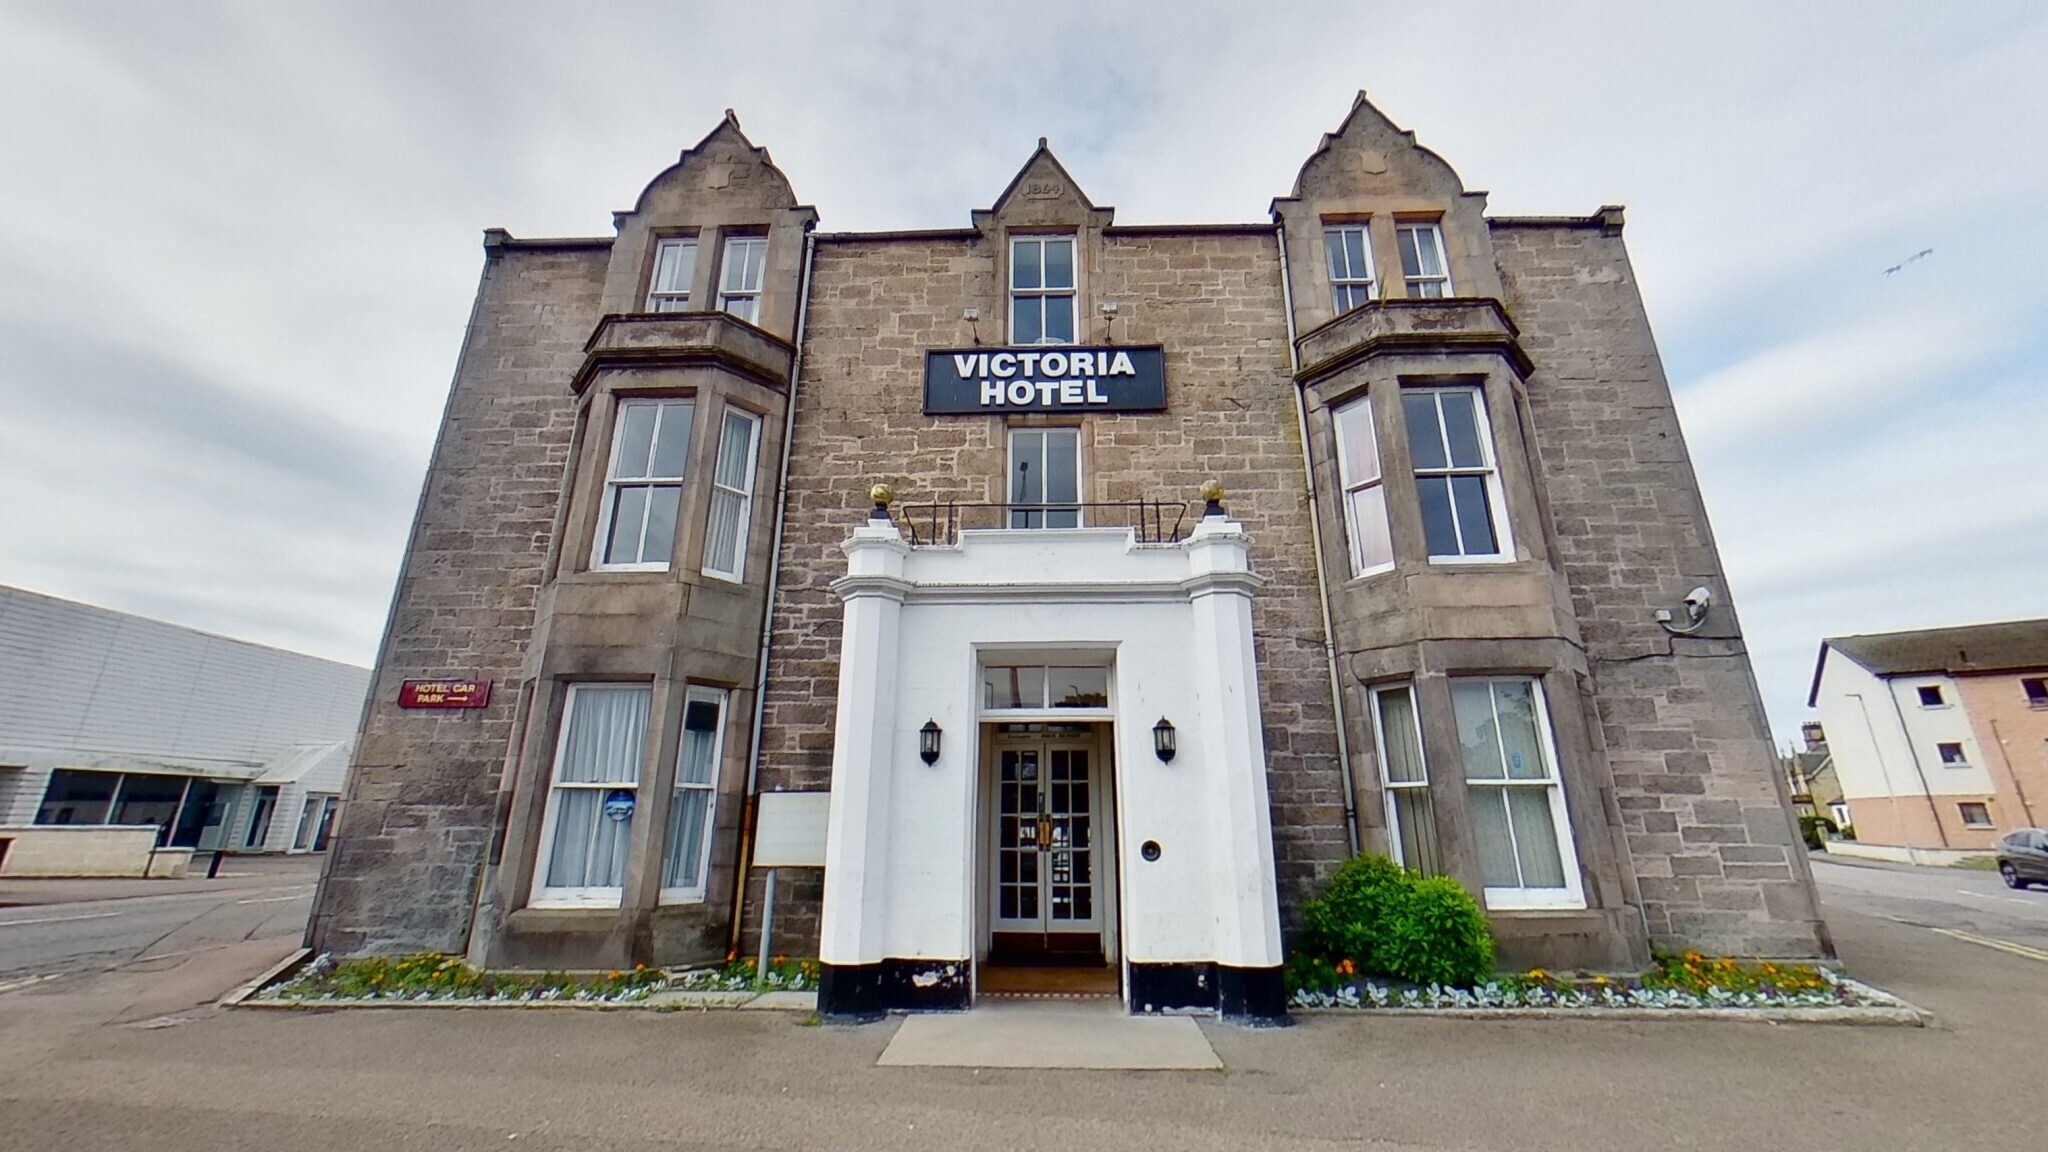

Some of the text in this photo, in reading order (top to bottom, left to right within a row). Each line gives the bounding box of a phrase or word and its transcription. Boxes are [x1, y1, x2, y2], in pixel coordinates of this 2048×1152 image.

[954, 351, 1136, 378] VICTORIA
[980, 380, 1108, 406] HOTEL
[415, 684, 477, 693] HOTEL CAR
[416, 694, 445, 703] PARK
